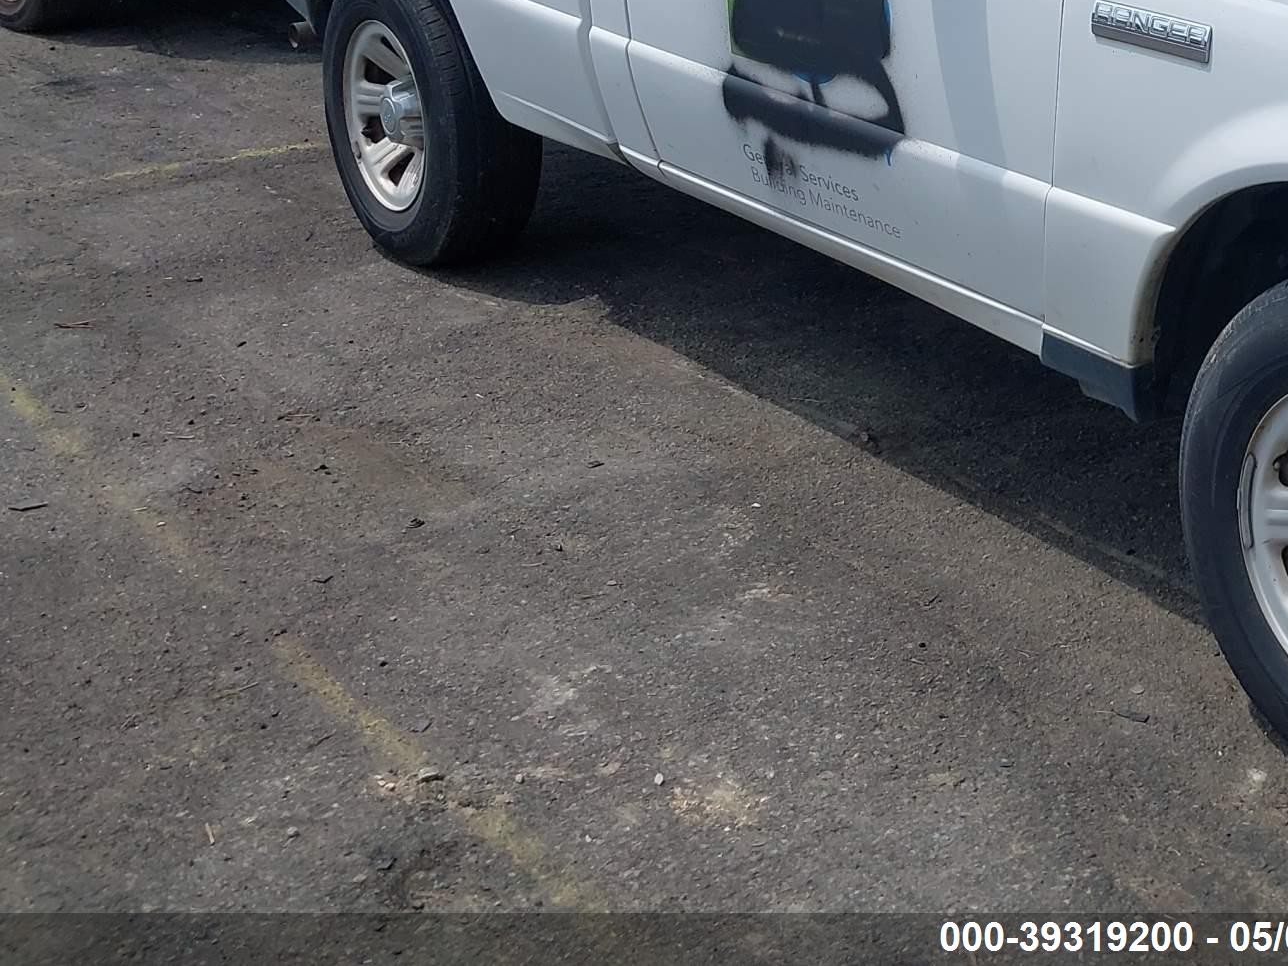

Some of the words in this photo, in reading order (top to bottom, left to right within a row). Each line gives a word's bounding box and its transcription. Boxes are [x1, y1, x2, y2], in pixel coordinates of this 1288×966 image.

[1092, 1, 1208, 48] RANGER
[799, 164, 859, 202] Services
[808, 188, 900, 238] Maintenance
